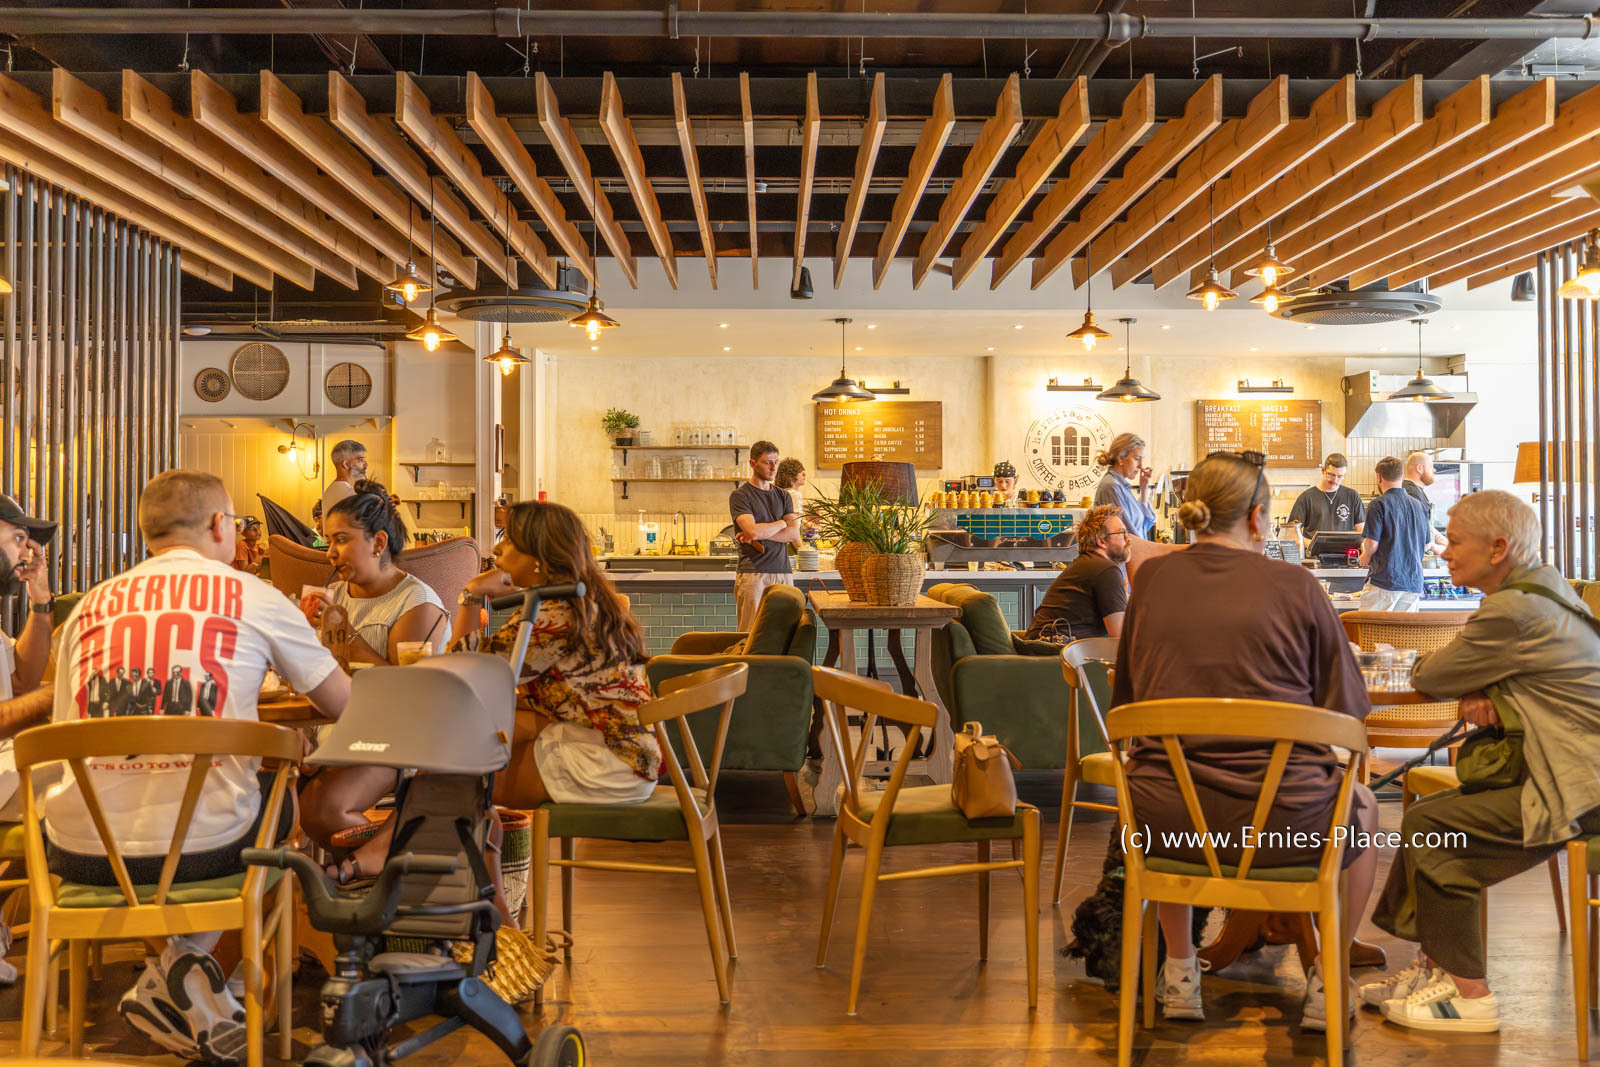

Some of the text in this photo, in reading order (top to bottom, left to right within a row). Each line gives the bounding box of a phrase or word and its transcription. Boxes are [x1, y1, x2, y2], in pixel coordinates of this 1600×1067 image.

[1032, 458, 1056, 486] COFFEE
[1056, 480, 1065, 489] &
[1068, 474, 1095, 490] BAGEL
[78, 574, 243, 632] RESERVOIR
[326, 629, 346, 644] 10
[119, 762, 144, 770] GO
[146, 761, 170, 769] TO
